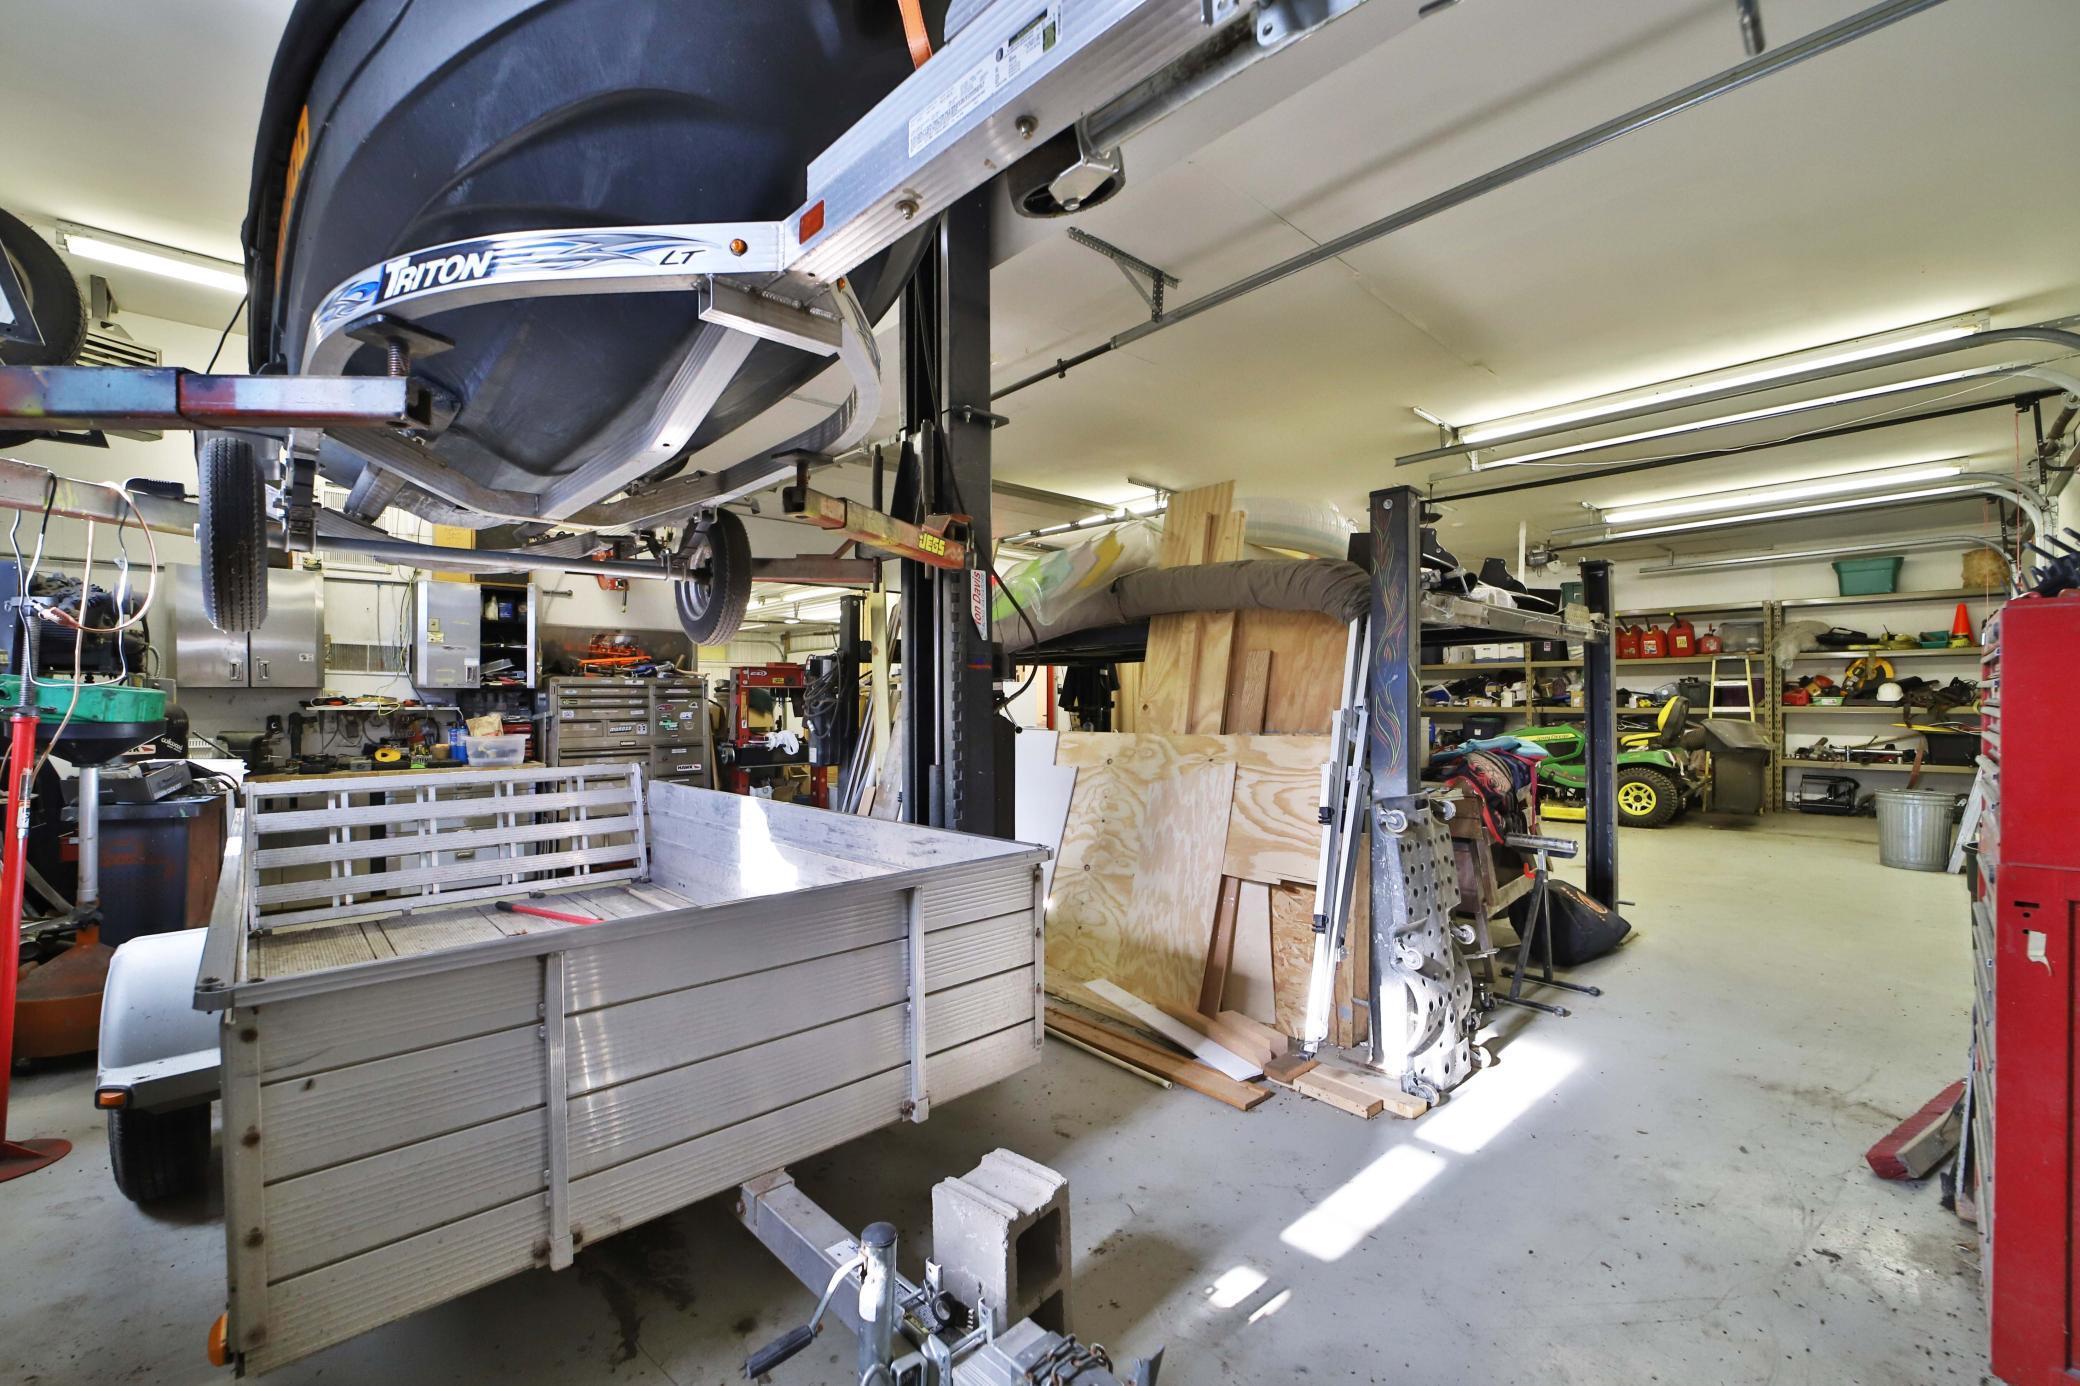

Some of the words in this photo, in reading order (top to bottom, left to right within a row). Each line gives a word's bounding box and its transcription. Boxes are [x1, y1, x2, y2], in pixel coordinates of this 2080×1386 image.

[659, 249, 707, 266] LT
[384, 250, 494, 300] TRITON
[919, 534, 945, 557] JEGS
[972, 571, 981, 604] Davis
